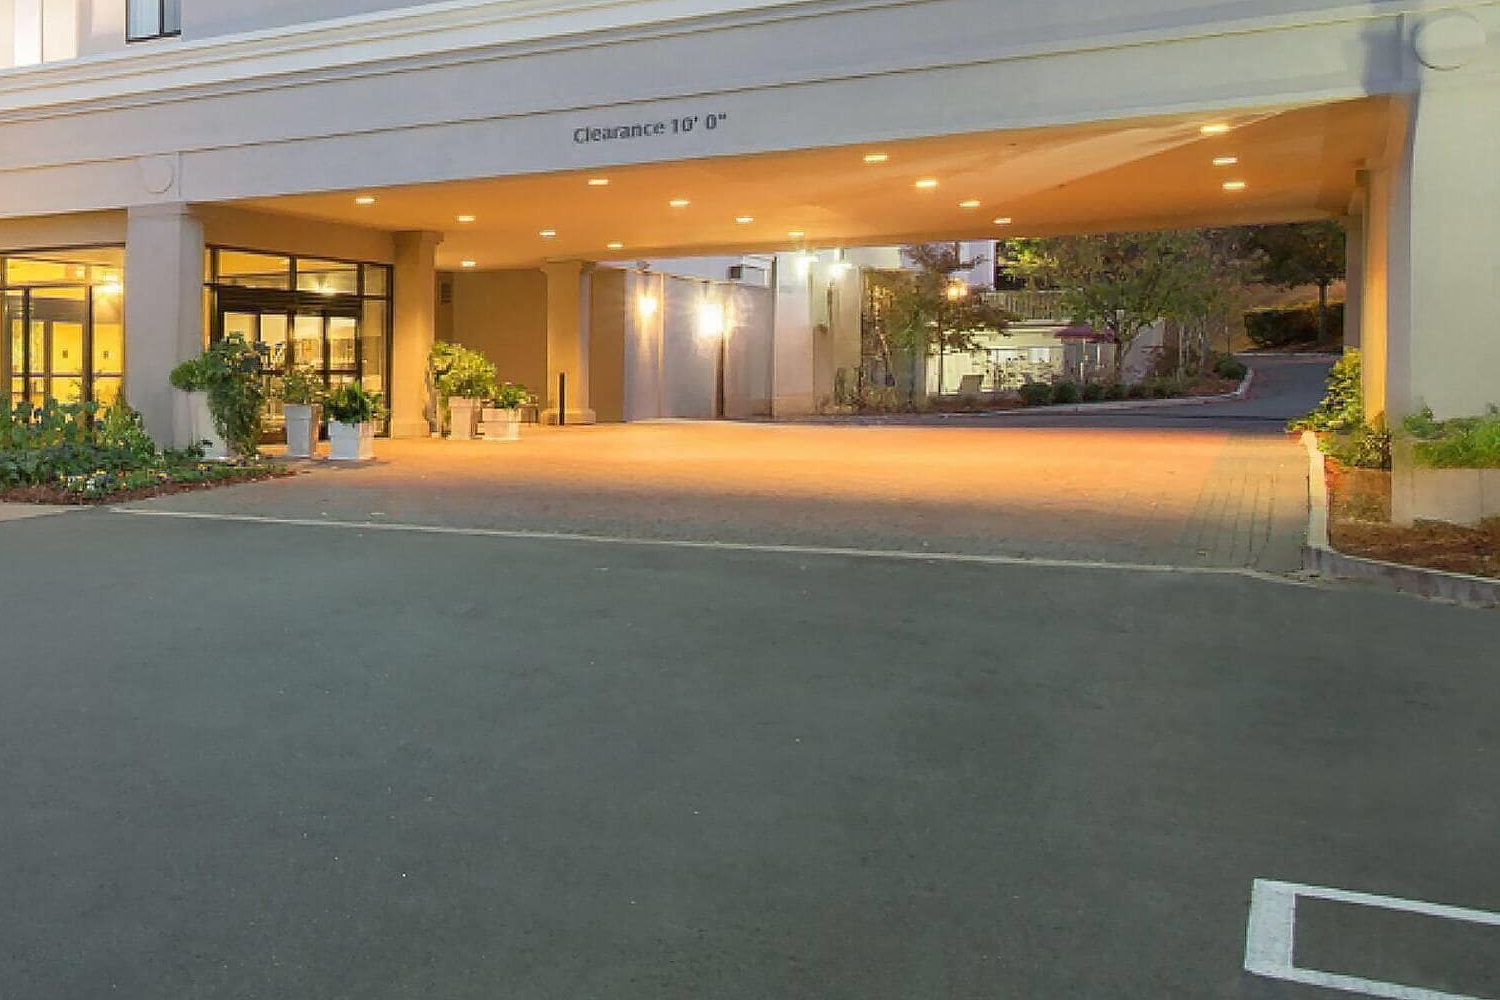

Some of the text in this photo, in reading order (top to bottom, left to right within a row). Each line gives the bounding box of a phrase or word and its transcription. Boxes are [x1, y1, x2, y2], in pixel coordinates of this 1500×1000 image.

[573, 113, 727, 144] Clearance 10' 0"
